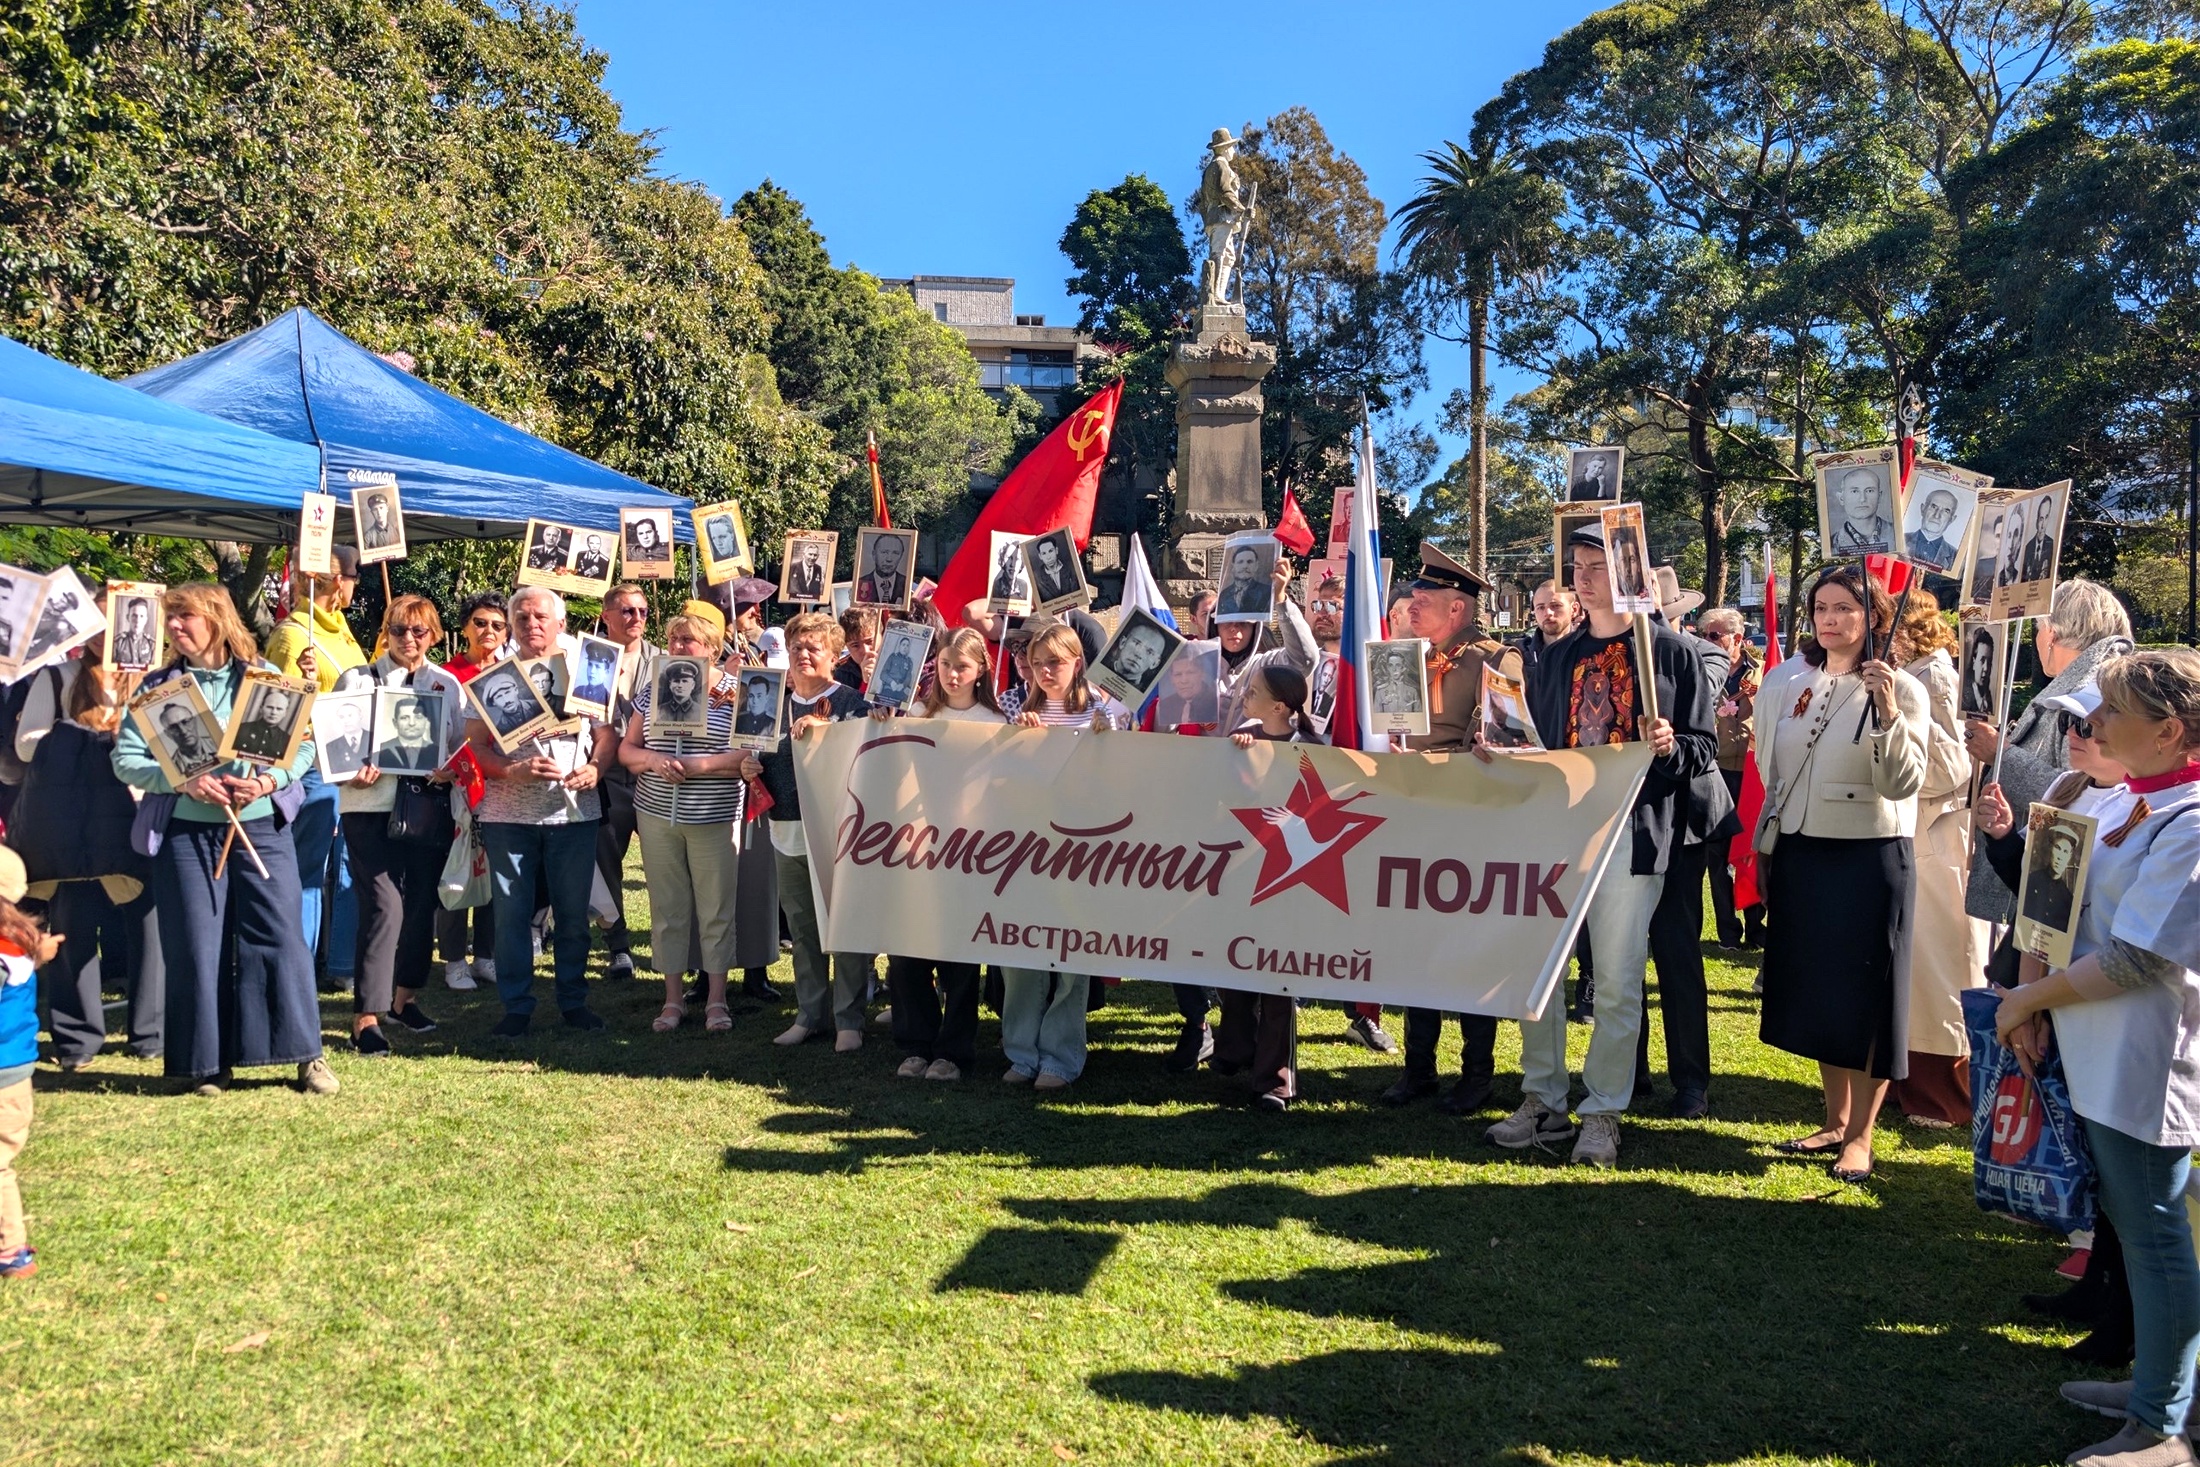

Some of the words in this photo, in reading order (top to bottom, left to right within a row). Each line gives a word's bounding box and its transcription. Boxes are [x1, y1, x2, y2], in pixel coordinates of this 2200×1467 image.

[1376, 855, 1569, 919] ПОЛК
[971, 911, 1169, 963] Австралия
[1226, 935, 1373, 983] Сидней
[2014, 1173, 2047, 1197] ЦЕНА
